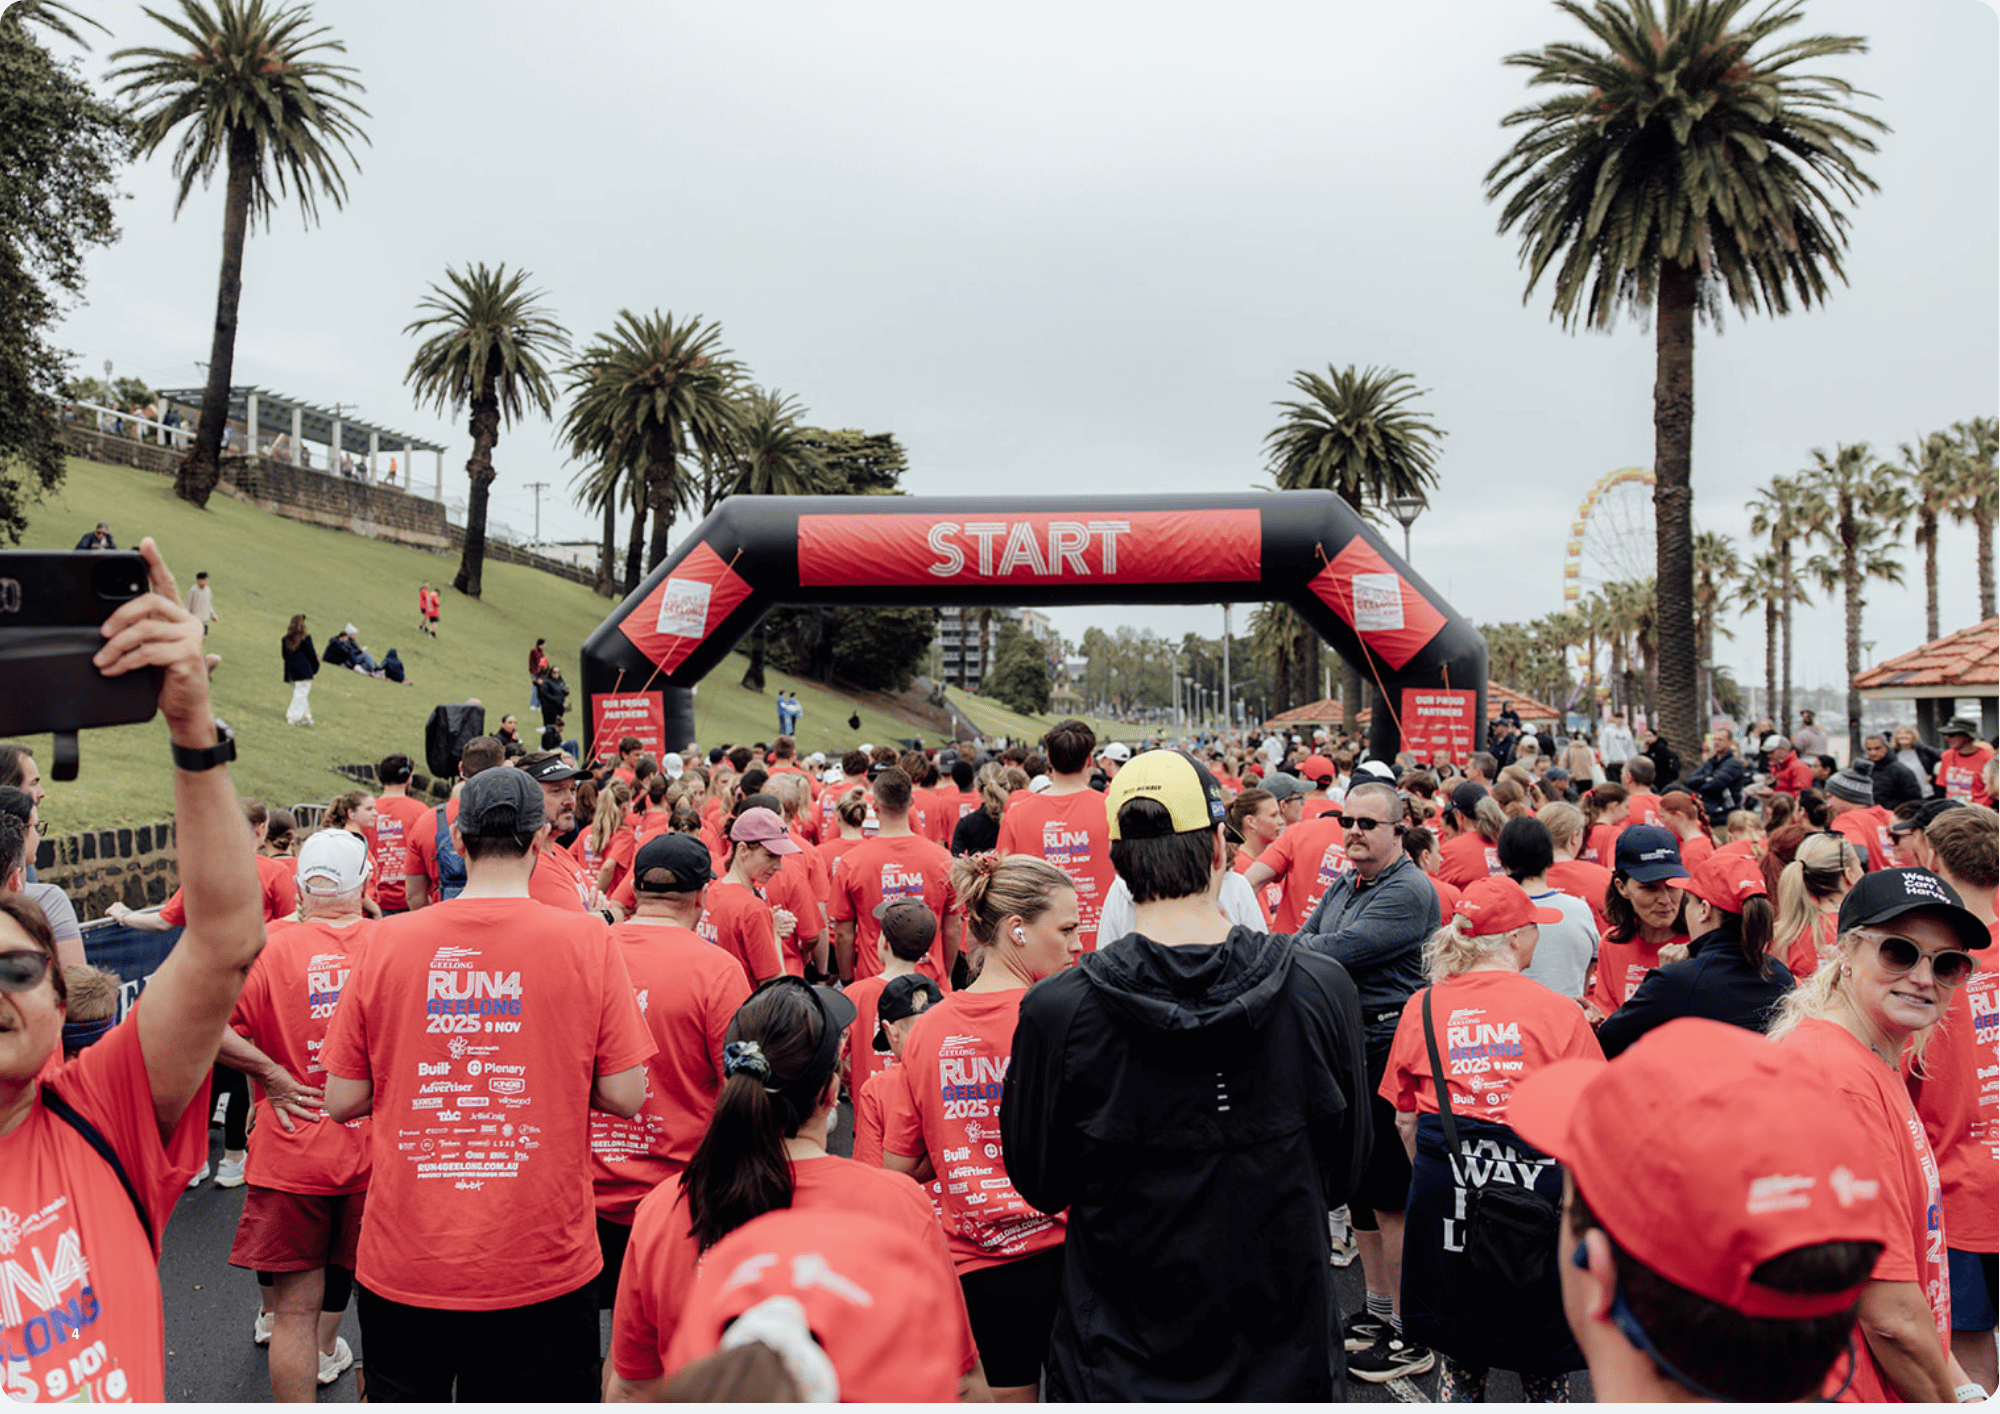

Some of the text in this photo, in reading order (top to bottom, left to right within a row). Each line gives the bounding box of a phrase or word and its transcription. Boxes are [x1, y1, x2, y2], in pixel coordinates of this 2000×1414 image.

[927, 521, 1131, 577] START
[602, 698, 650, 709] OUR PROUD
[1415, 695, 1465, 706] OUR PROUD
[604, 709, 649, 719] PARTNERS
[1417, 707, 1463, 717] PARTNERS
[1043, 831, 1089, 850] RUN4
[1045, 844, 1090, 855] GEELONG
[1321, 853, 1354, 874] RUN
[881, 872, 924, 888] RUN4
[1902, 873, 1937, 885] West
[1904, 880, 1935, 890] Carr
[1906, 887, 1951, 904] Harvey
[308, 969, 350, 997] RU
[427, 970, 523, 1001] RUN4
[427, 998, 522, 1015] GEELONG
[426, 1013, 521, 1034] 2025 9 NOV
[1447, 1022, 1521, 1050] RUN4
[939, 1048, 976, 1057] GEELONG
[1449, 1043, 1522, 1060] GEELONG
[418, 1062, 526, 1076] Built Plenary
[1450, 1056, 1491, 1074] 2025
[1502, 1061, 1523, 1070] NOV
[419, 1082, 473, 1094] Advertiser
[943, 1083, 1004, 1101] GEELO
[1453, 1093, 1476, 1105] Built
[437, 1110, 461, 1121] TAC
[943, 1099, 989, 1120] 2025
[943, 1146, 971, 1162] Built
[417, 1162, 519, 1172] RUN4GEELONG.COM.AU
[1448, 1153, 1543, 1191] WAY
[0, 1227, 90, 1328] N4
[45, 1368, 68, 1398] 9
